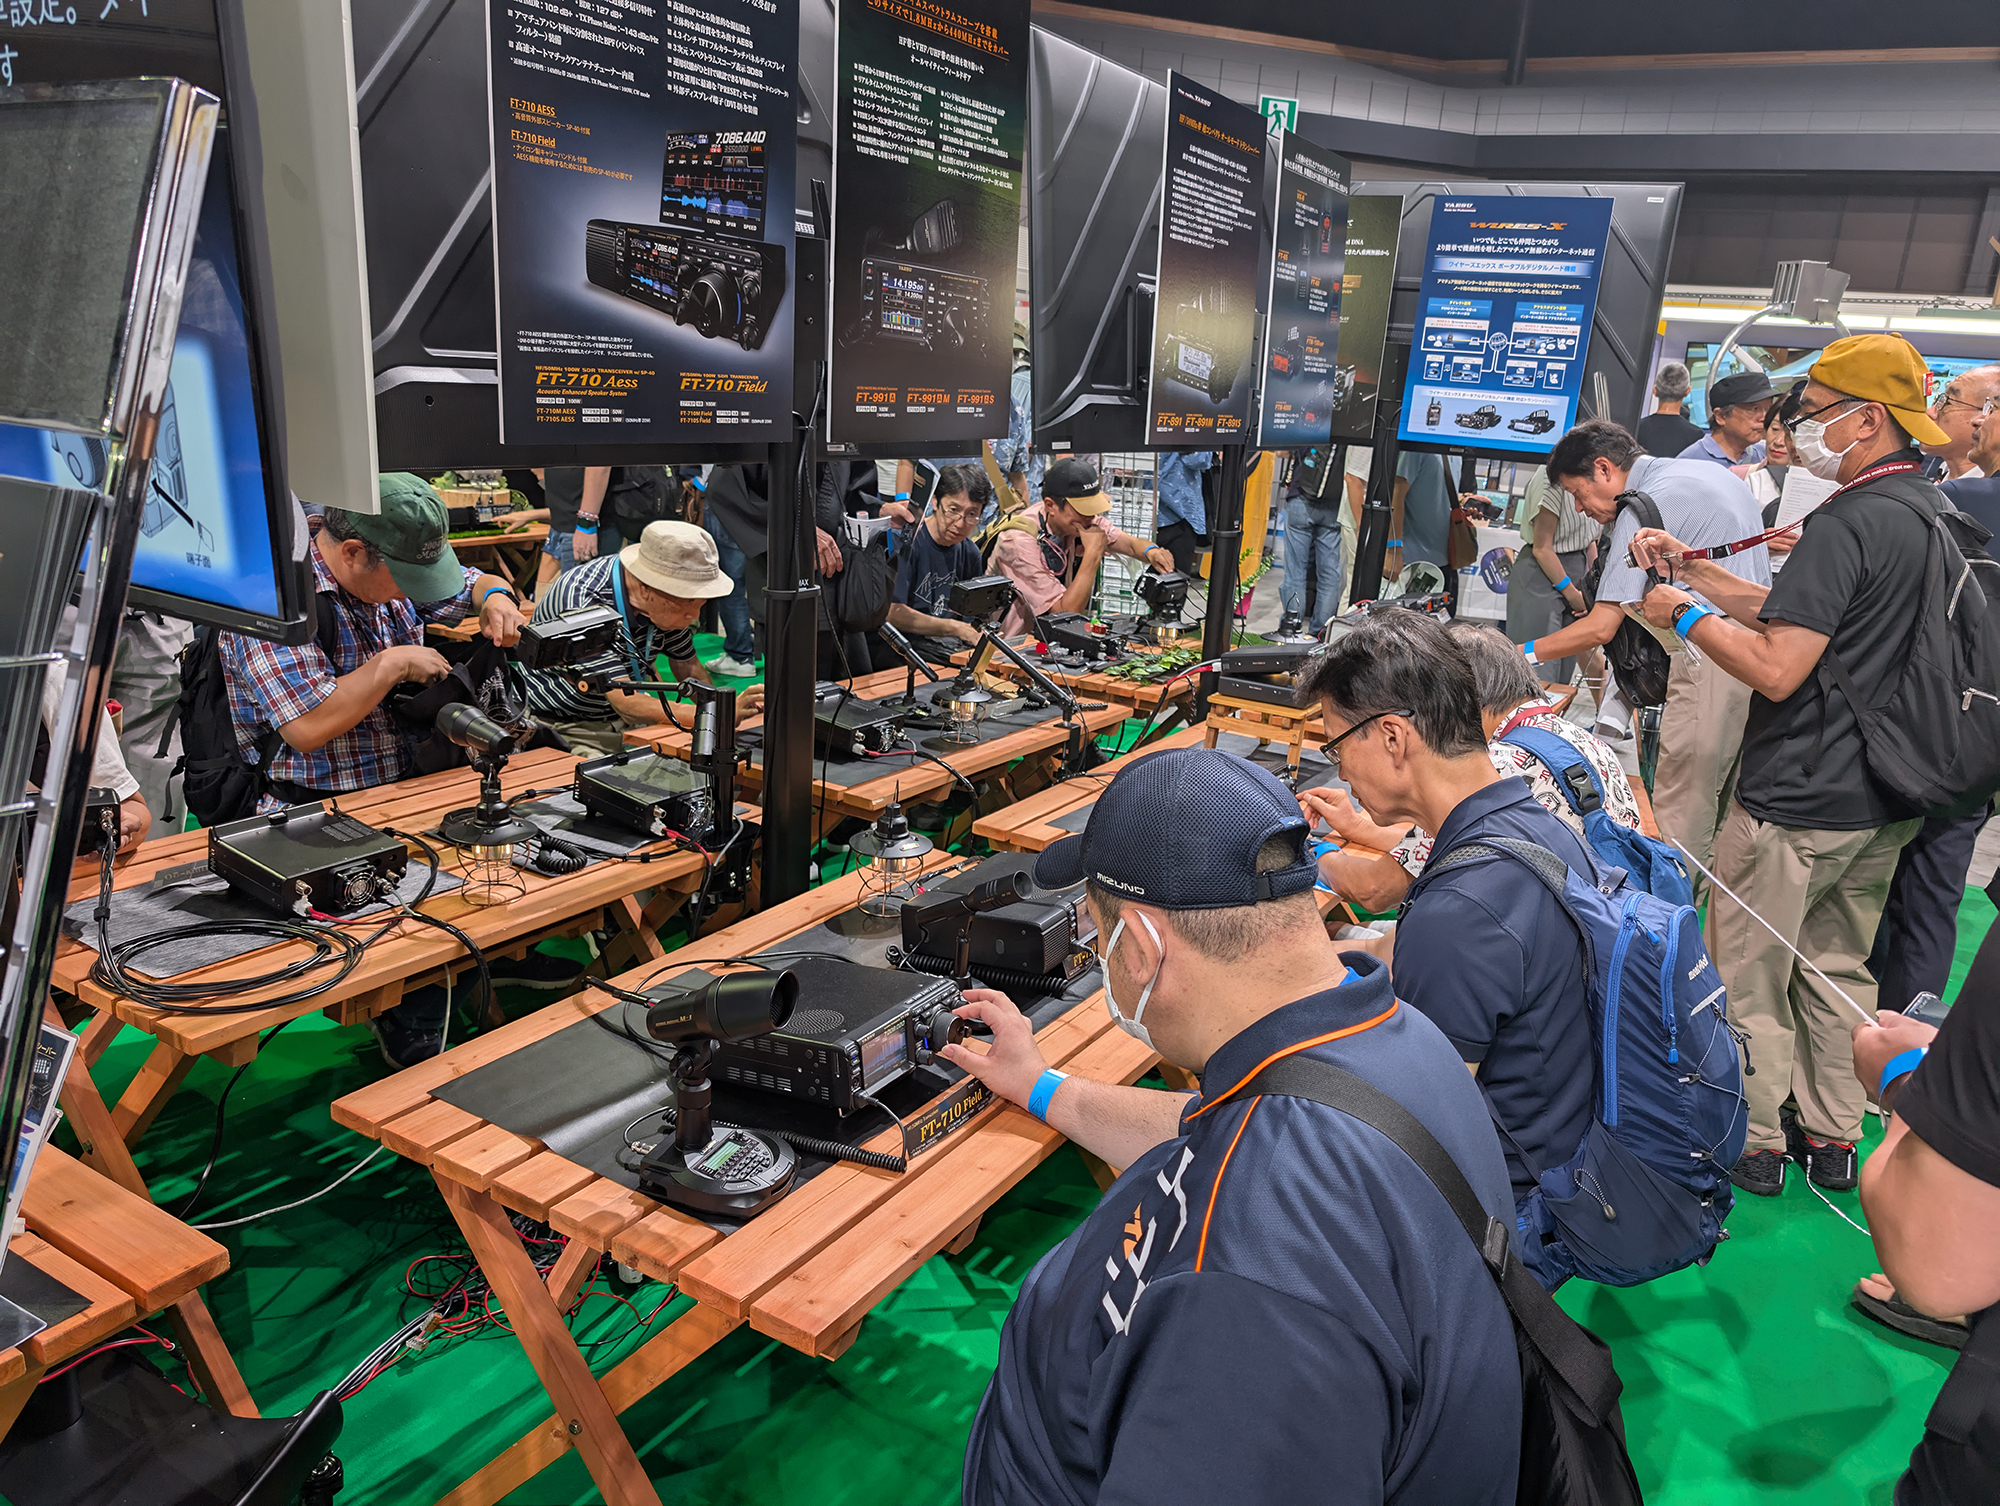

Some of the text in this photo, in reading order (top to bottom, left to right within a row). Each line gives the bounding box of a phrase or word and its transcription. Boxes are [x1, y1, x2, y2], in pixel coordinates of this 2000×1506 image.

[510, 98, 556, 117] FT-710 AESS
[511, 129, 556, 148] FT-710 Field
[715, 131, 767, 145] 7.086.440
[1470, 222, 1568, 230] WIRES-X
[1473, 237, 1559, 246] いつでも、どこでも仲間とつながる
[1449, 261, 1576, 273] ワイヤーズエックス ポータブルデジタルノード機能
[536, 372, 639, 388] FT-710 Aess
[680, 377, 769, 393] FT-710 Field
[562, 388, 587, 396] Enhanced
[588, 389, 609, 397] Speaker
[856, 392, 896, 403] FT-991A
[907, 393, 950, 403] FT-991AM
[536, 416, 561, 424] FT-710S
[561, 416, 575, 424] AESS
[1157, 416, 1182, 426] FT-891
[186, 552, 211, 568] 端子面
[1097, 872, 1145, 895] MIZUNO
[920, 1102, 962, 1143] FT-710
[963, 1088, 983, 1113] Field
